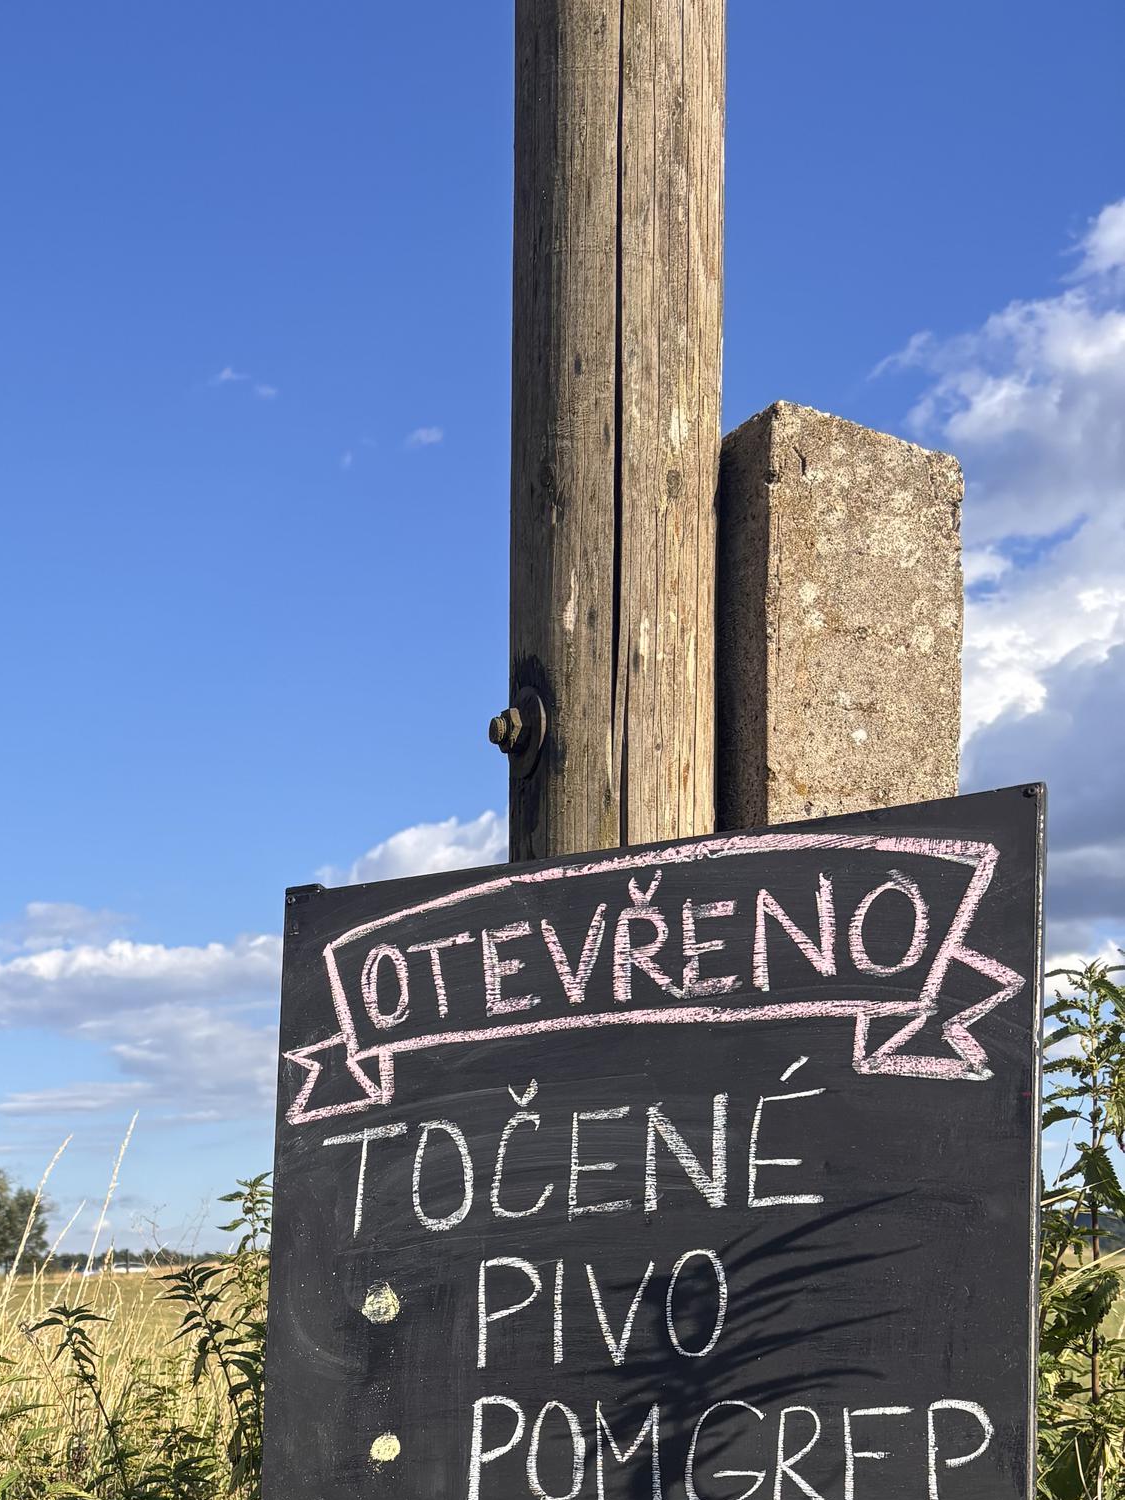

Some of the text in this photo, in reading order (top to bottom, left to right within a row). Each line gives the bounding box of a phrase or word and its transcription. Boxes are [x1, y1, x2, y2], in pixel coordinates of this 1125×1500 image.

[360, 870, 929, 1030] OTEVŘENO
[322, 1056, 826, 1239] TOČENÉ
[476, 1248, 728, 1370] PIVO
